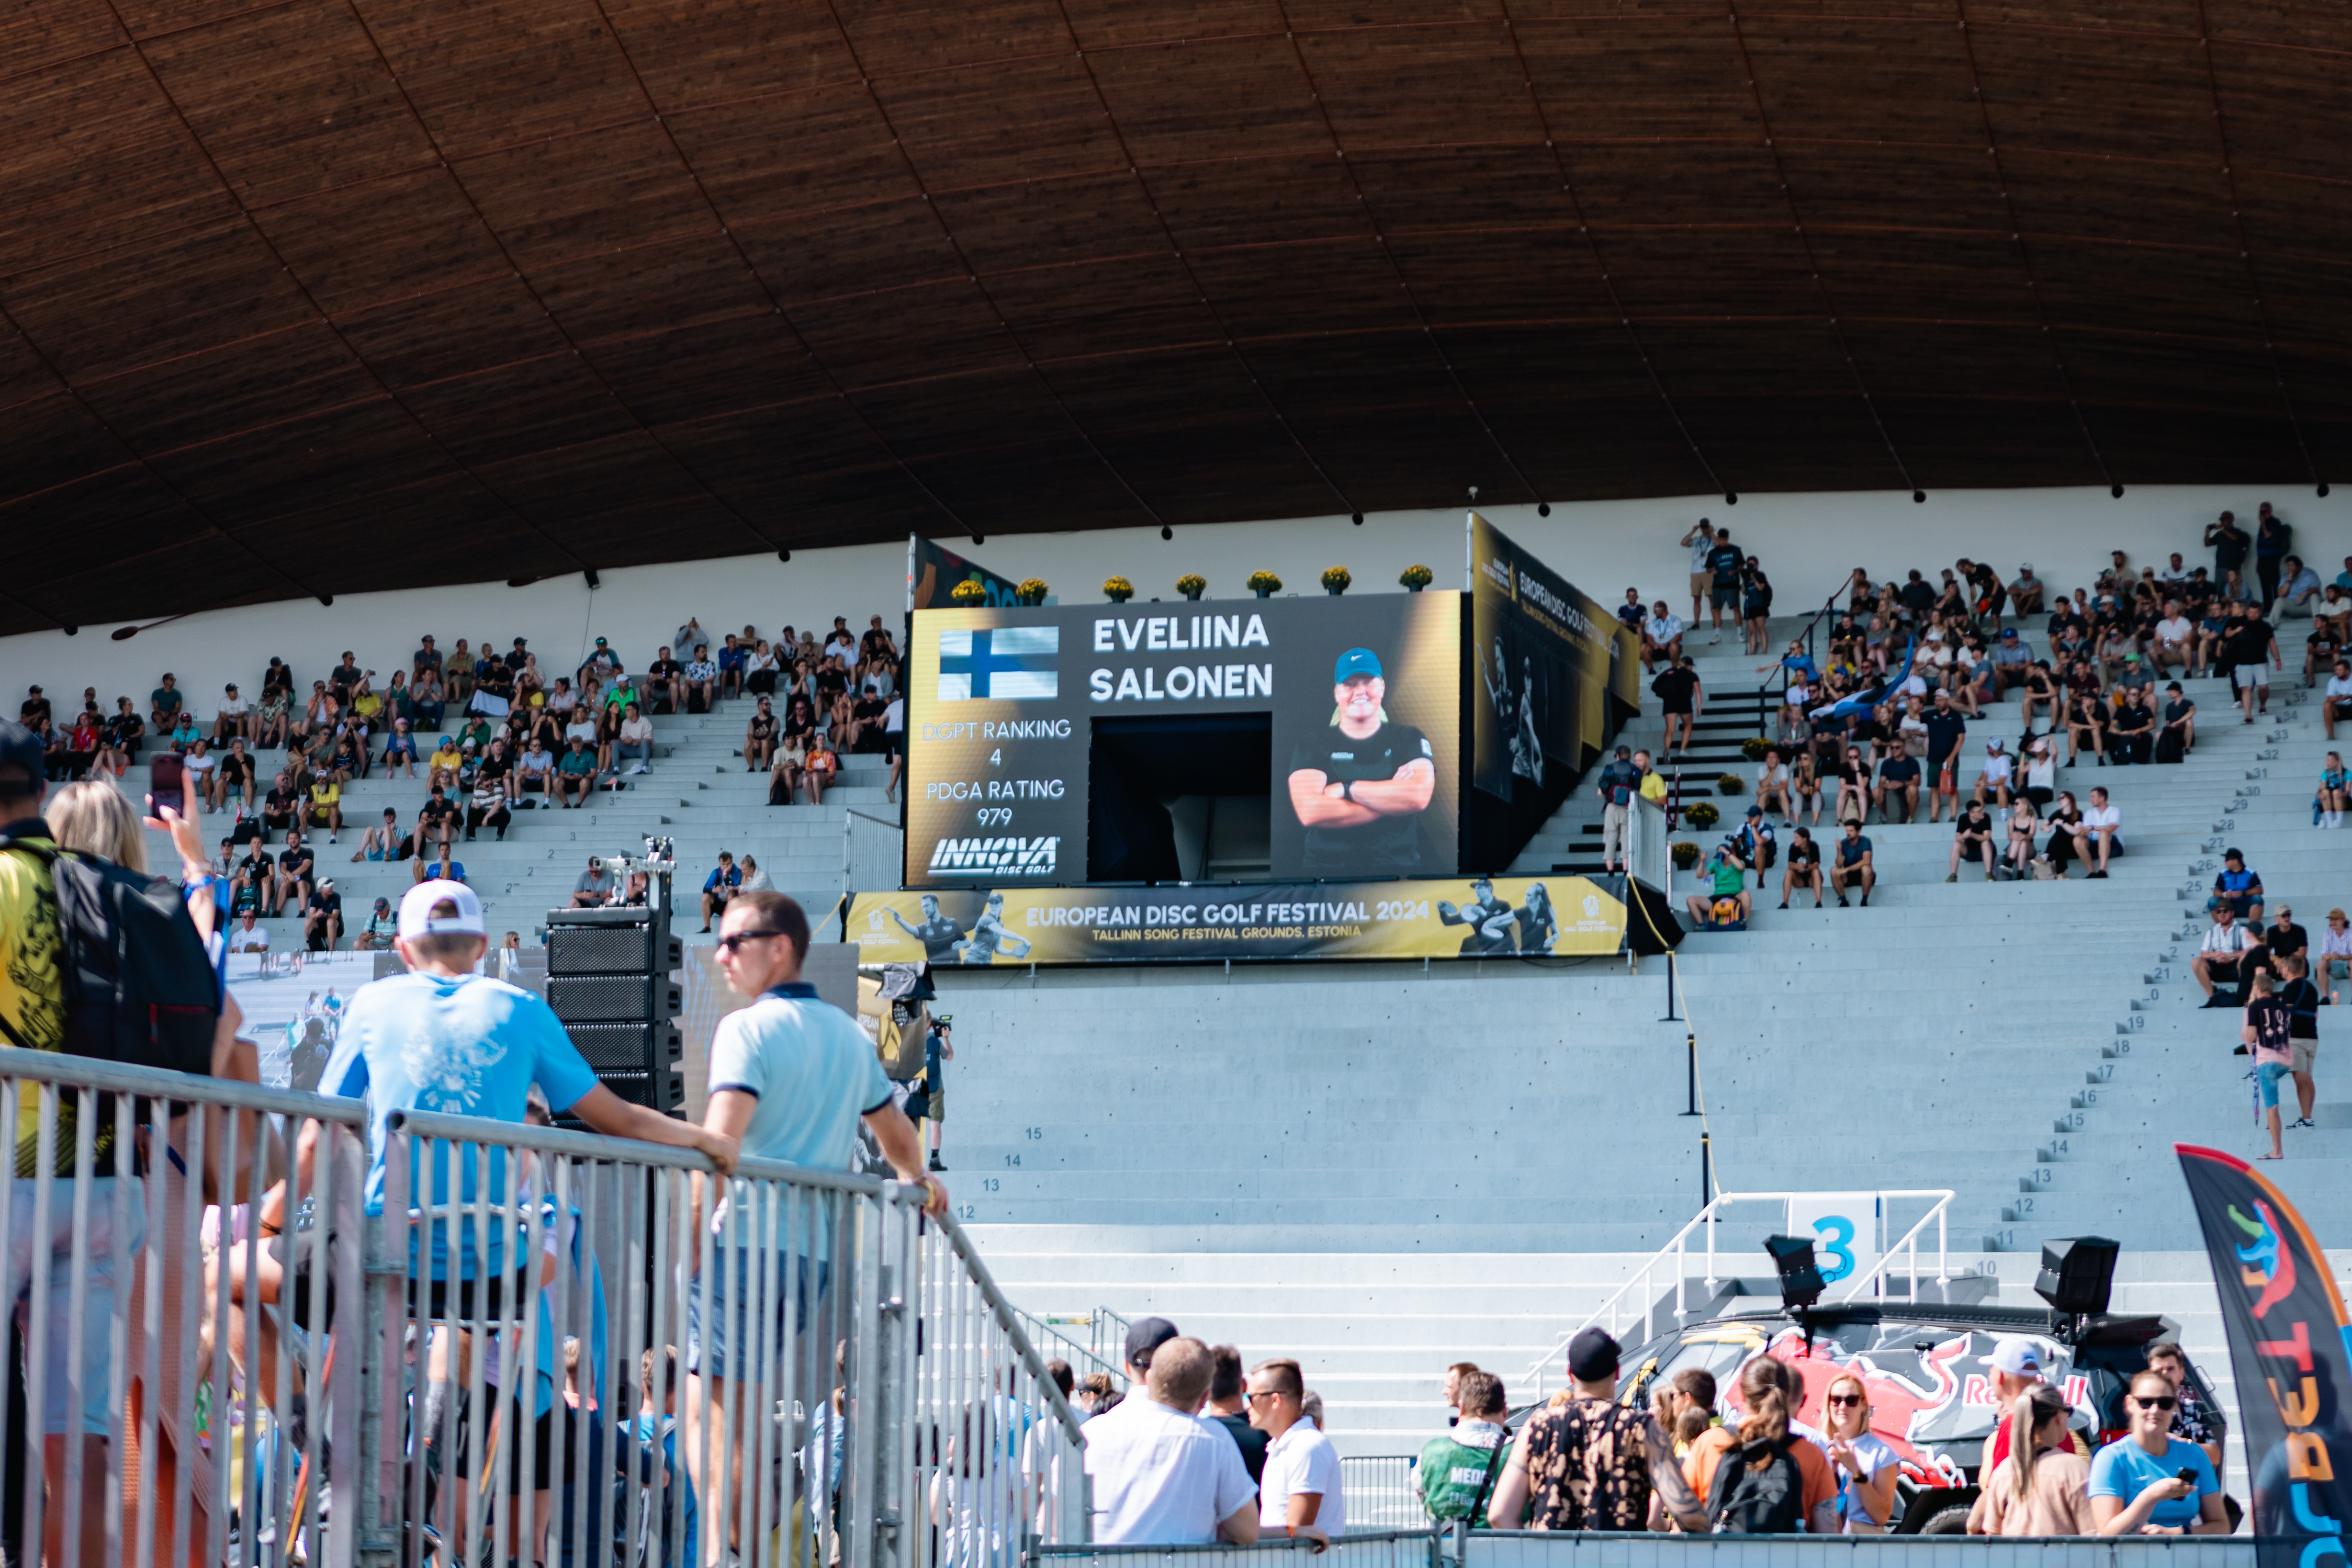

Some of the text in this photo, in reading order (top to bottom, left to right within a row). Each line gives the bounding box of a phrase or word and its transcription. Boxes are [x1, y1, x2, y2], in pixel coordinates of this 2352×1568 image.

[1520, 571, 1552, 611] EUROPEAN
[1551, 595, 1566, 621] DISC
[1566, 605, 1584, 632] GOLF
[1094, 614, 1270, 652] EVELIINA
[1089, 663, 1273, 702] SALONEN
[923, 719, 1071, 740] DGPT RANKING
[2274, 729, 2289, 740] 33
[989, 748, 1002, 766] 4
[2263, 749, 2279, 760] 32
[2253, 767, 2267, 779] 31
[926, 778, 1065, 801] PDGA RATING
[2232, 799, 2248, 810] 29
[977, 807, 1013, 826] 979
[2219, 819, 2235, 831] 28
[929, 836, 1057, 868] INNOVA
[995, 865, 1056, 875] DISC GOLF
[2196, 859, 2214, 871] 26
[2185, 880, 2202, 892] 25
[1026, 900, 1429, 927] EUROPEAN DISC GOLF FESTIVAL 2024
[1092, 929, 1142, 941] TALLINN
[1144, 928, 1180, 940] SONG
[1182, 927, 1239, 939] FESTIVAL
[1307, 925, 1362, 937] ESTONIA
[2154, 967, 2170, 979] 21
[2127, 1015, 2145, 1028] 19
[2113, 1039, 2130, 1053] 18
[2097, 1064, 2115, 1078] 17
[2079, 1089, 2097, 1103] 16
[2067, 1112, 2084, 1126] 15
[1025, 1127, 1042, 1140] 15
[2050, 1139, 2069, 1153] 14
[1005, 1154, 1022, 1167] 14
[2033, 1168, 2051, 1183] 13
[983, 1178, 1000, 1192] 13
[957, 1205, 975, 1218] 12
[2014, 1198, 2034, 1212] 12
[1996, 1229, 2013, 1245] 11
[1812, 1215, 1856, 1284] 3
[1977, 1260, 1996, 1275] 10
[1966, 1376, 1997, 1405] Re
[1450, 1466, 1495, 1488] MEDI
